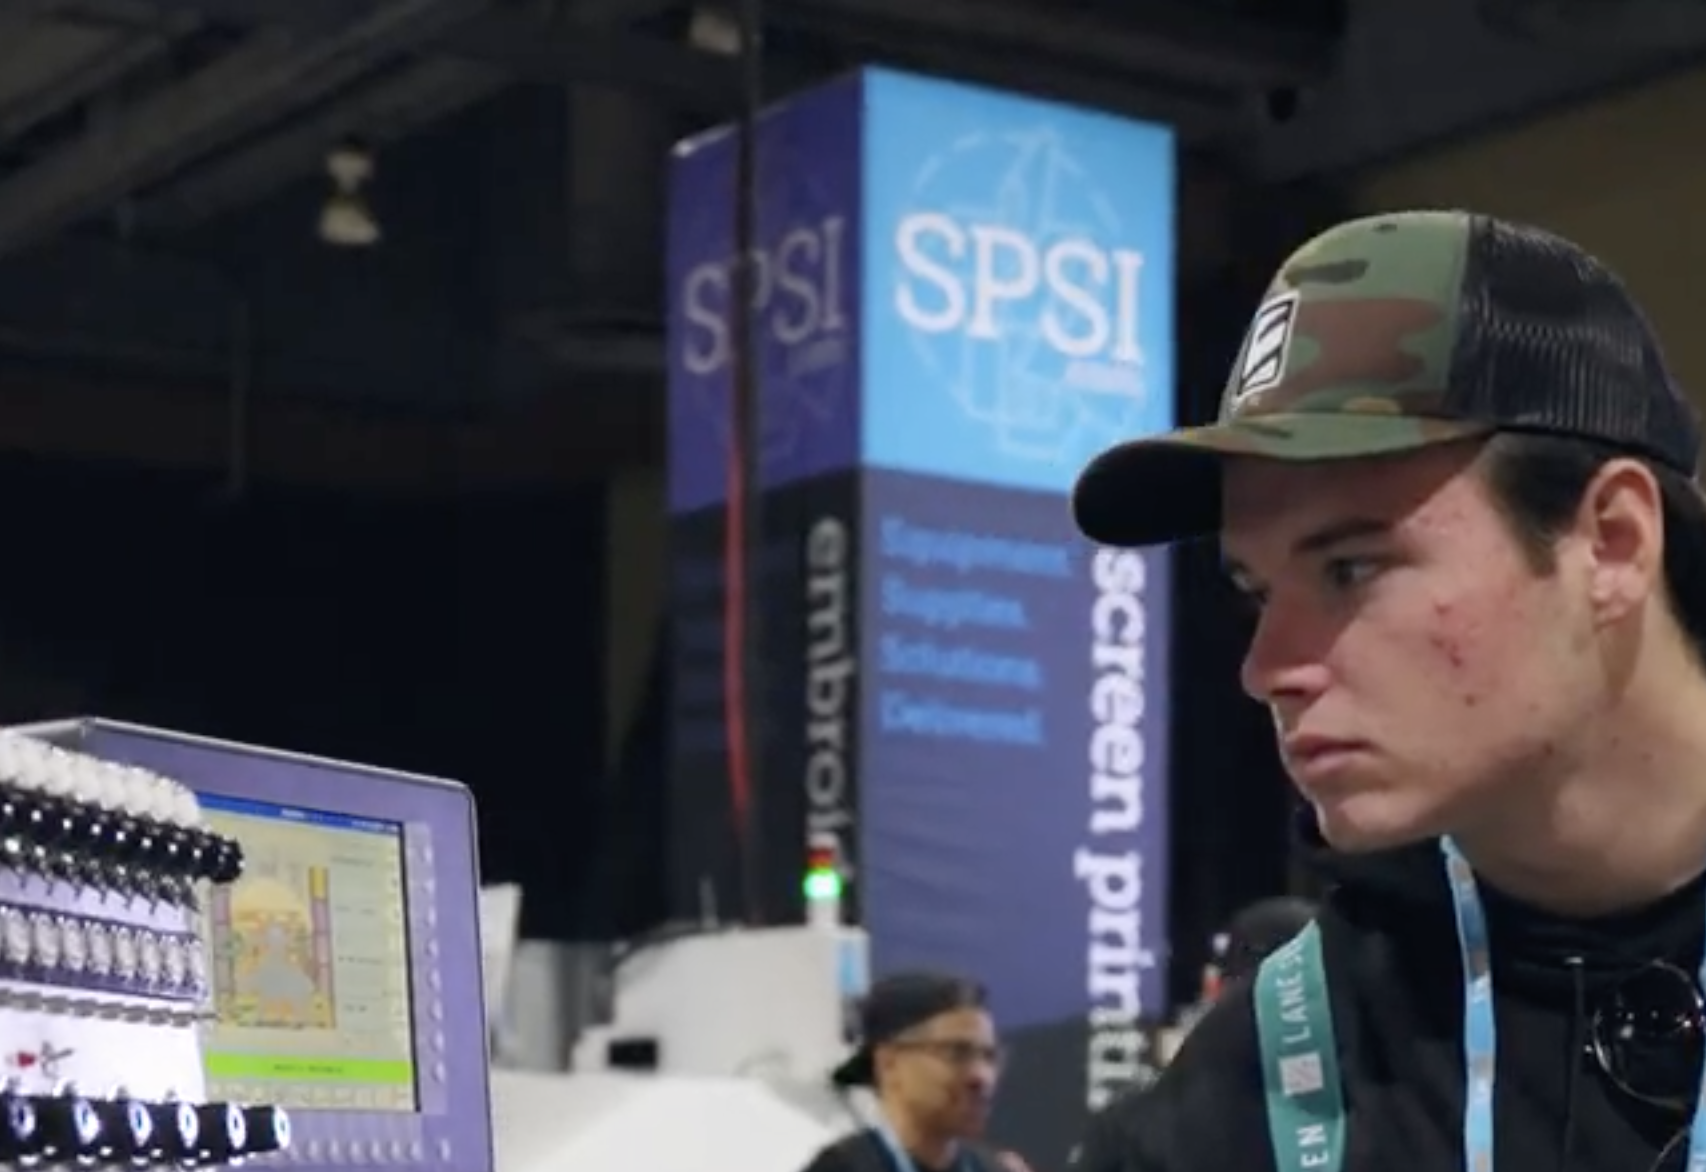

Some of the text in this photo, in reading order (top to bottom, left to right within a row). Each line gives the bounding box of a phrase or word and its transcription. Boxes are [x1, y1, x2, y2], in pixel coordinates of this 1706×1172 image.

[894, 211, 1145, 364] SPSI
[806, 515, 855, 878] embroi
[1073, 546, 1156, 1112] screen printi
